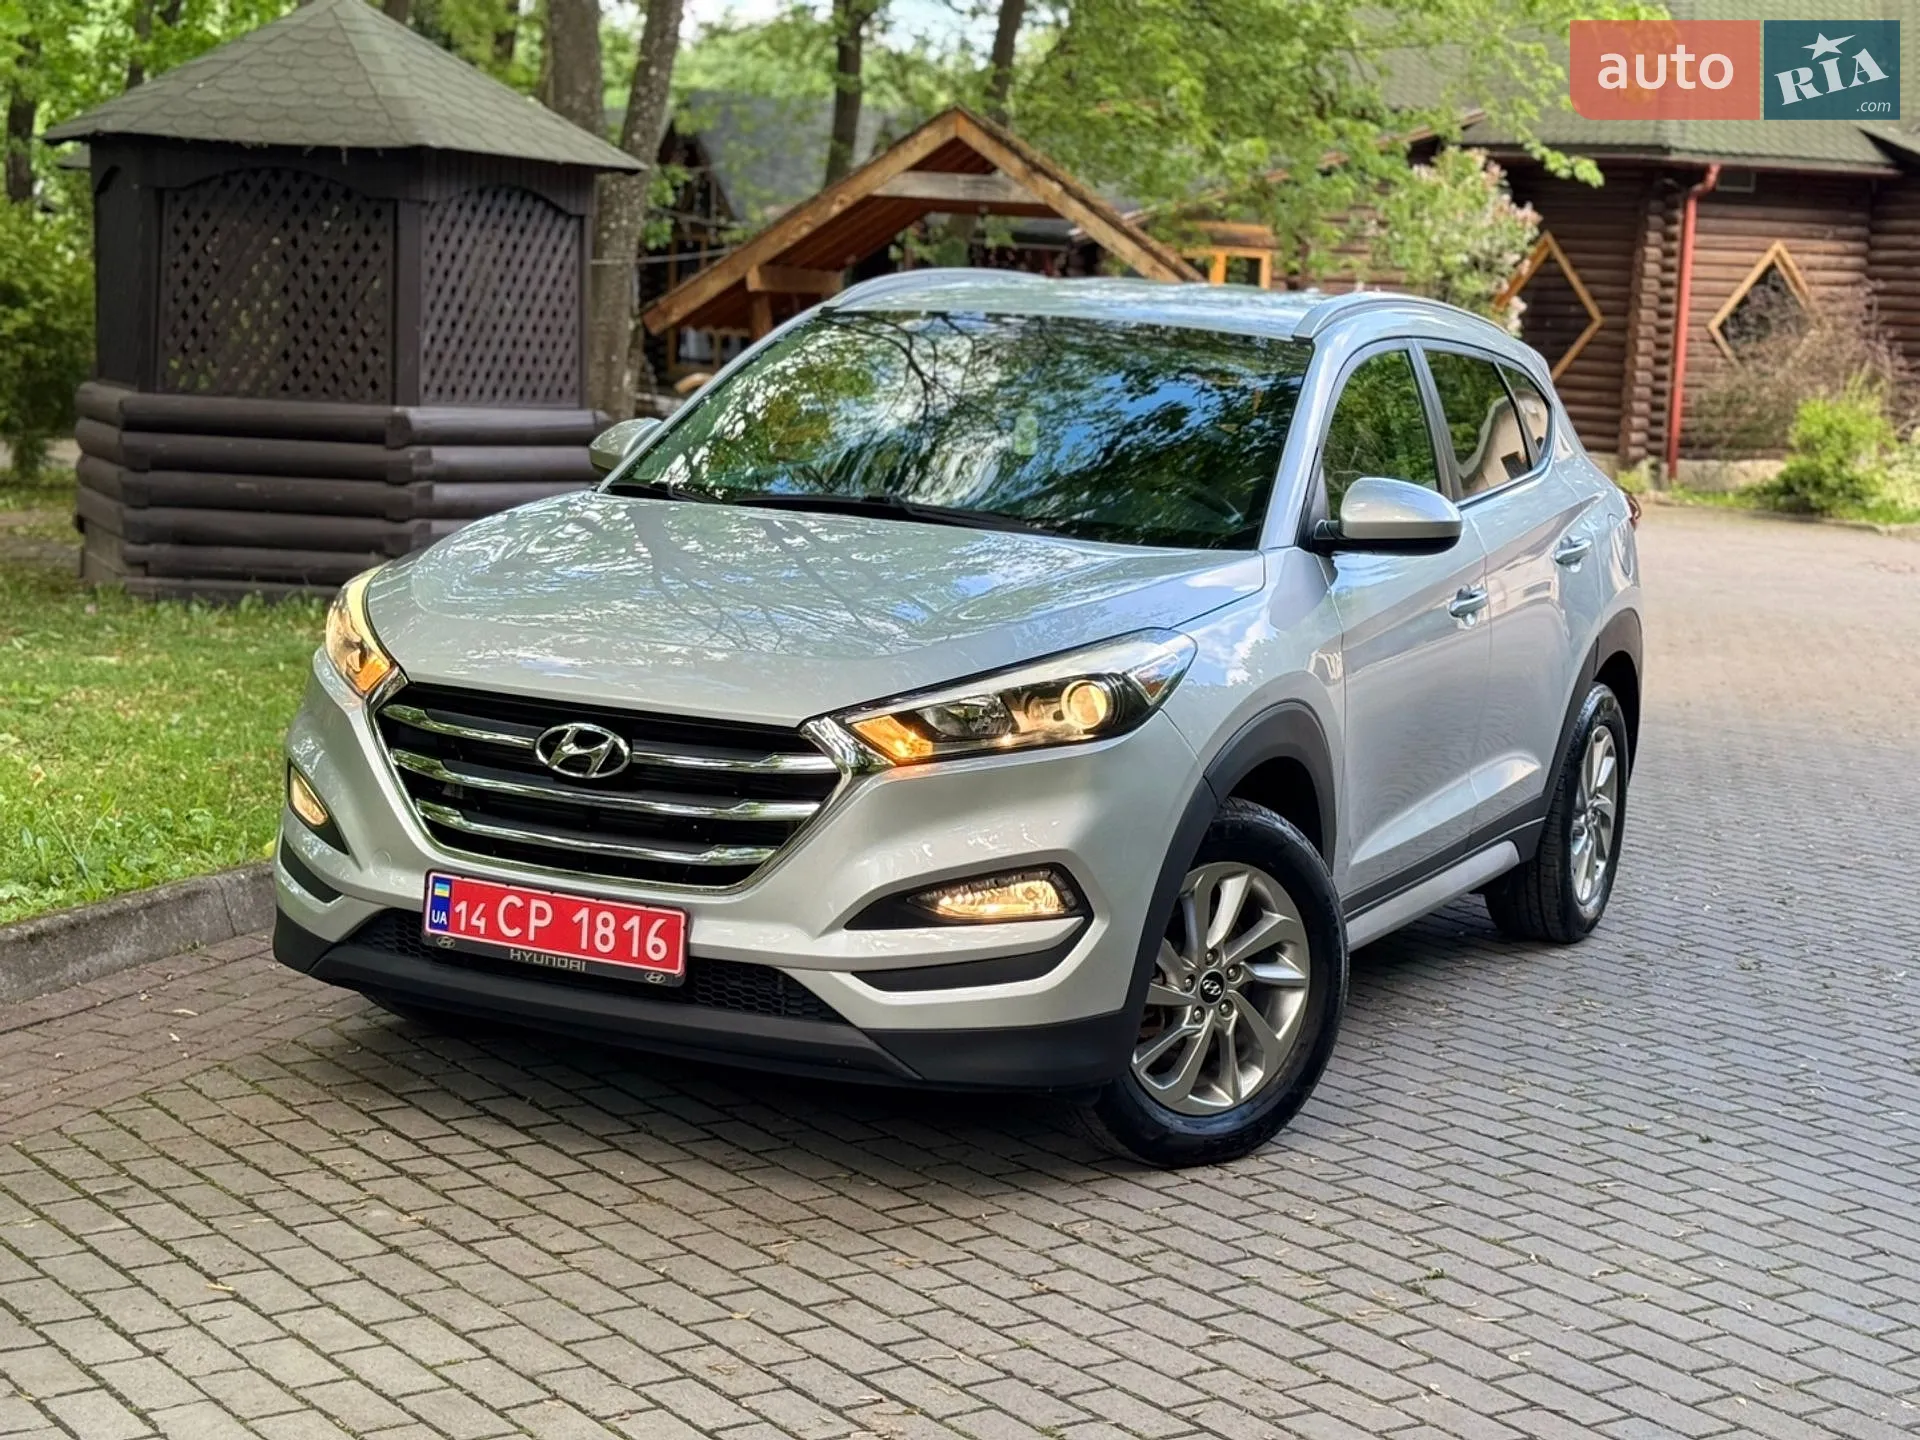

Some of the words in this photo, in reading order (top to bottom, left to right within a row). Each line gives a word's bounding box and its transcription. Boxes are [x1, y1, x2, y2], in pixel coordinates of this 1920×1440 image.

[431, 909, 448, 925] UA
[454, 901, 486, 934] 14
[497, 895, 553, 941] CP
[572, 907, 668, 961] 1816
[509, 948, 587, 972] HYUNDAI
